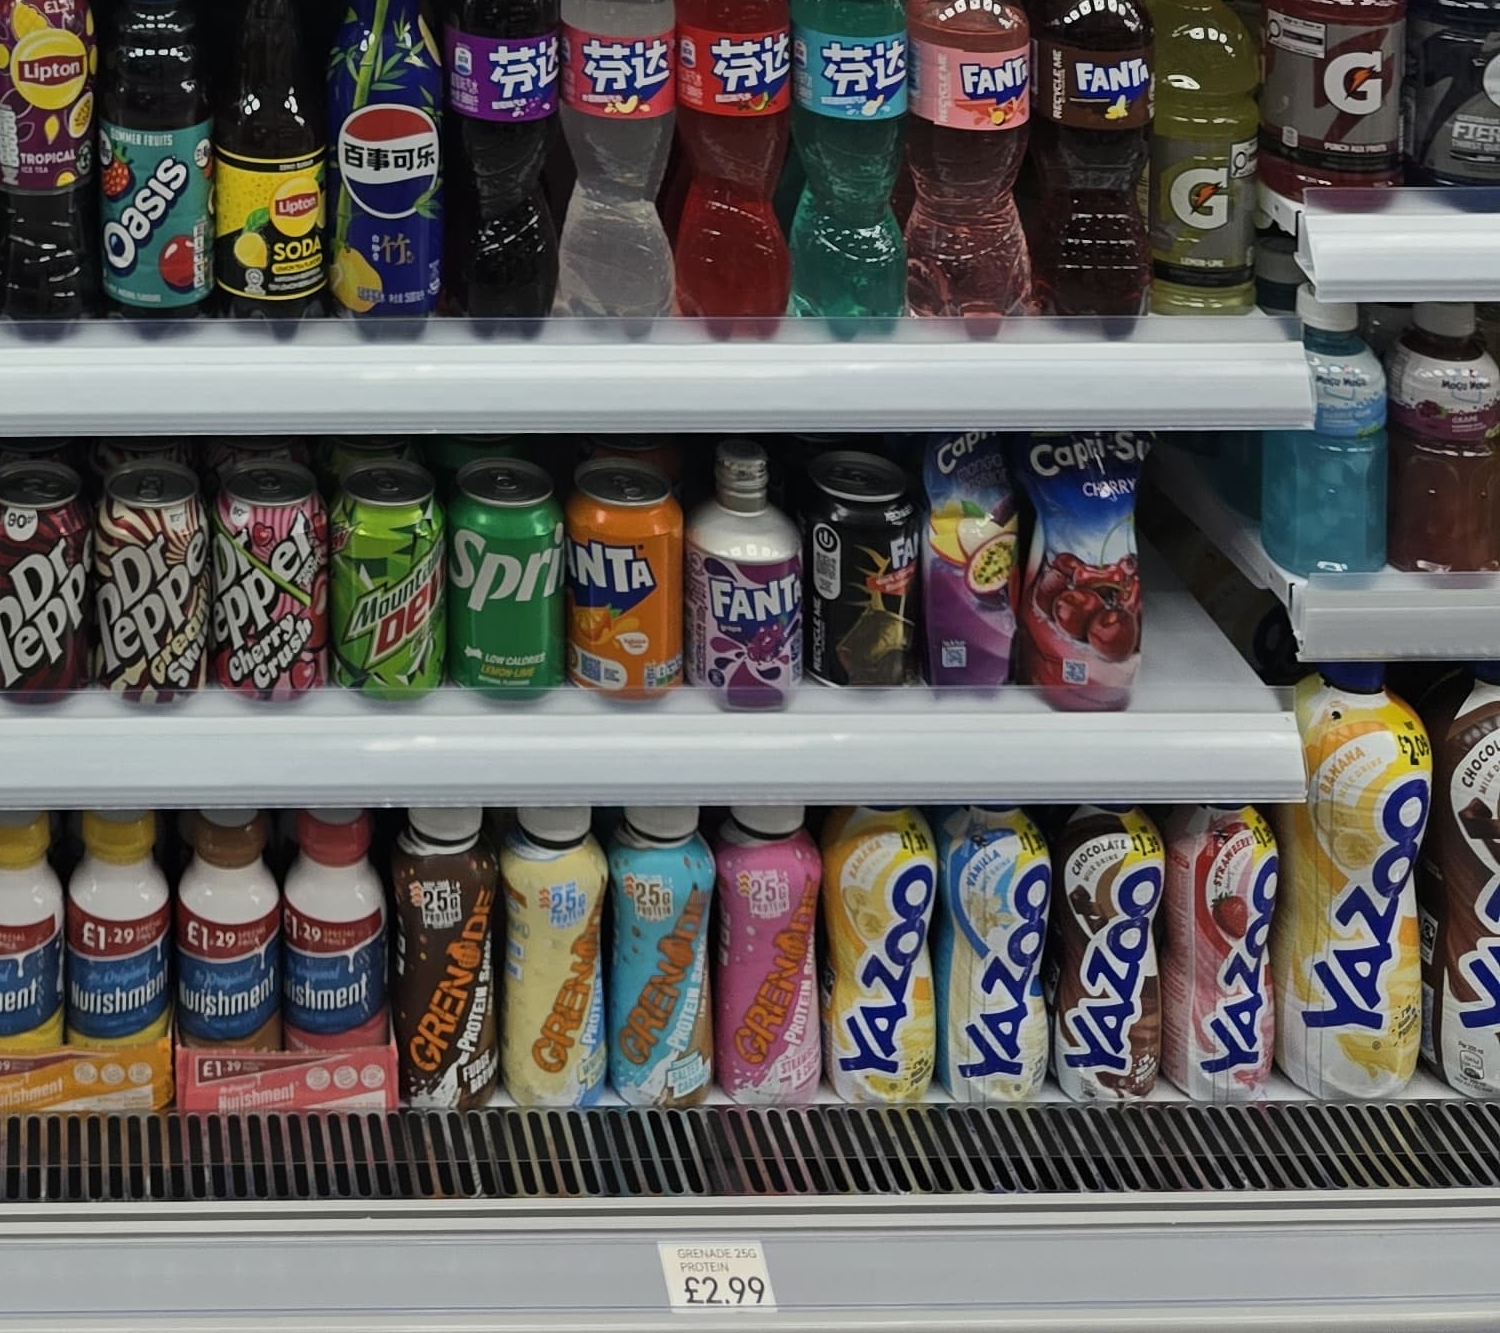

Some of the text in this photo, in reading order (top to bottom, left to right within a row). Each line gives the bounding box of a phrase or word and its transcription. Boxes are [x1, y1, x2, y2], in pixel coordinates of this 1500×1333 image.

[23, 59, 81, 80] Lipton
[582, 39, 670, 93] 芬达
[710, 34, 791, 93] 芬达
[1323, 50, 1383, 116] G
[20, 150, 76, 165] TROPICAL
[343, 142, 438, 173] 百事可乐
[1169, 167, 1229, 230] G
[273, 239, 322, 261] SODA
[228, 612, 296, 682] Cherry
[251, 616, 313, 691] Crush
[1318, 744, 1366, 795] BANANA
[1070, 838, 1128, 878] CHOCOLATE
[422, 888, 461, 915] 25G
[550, 888, 586, 913] 25G
[1300, 778, 1429, 1030] YAZOO
[82, 922, 135, 951] £1.29
[186, 921, 236, 949] £1.29
[839, 864, 935, 1075] YAZOO
[958, 863, 1051, 1079] YAZOO
[1065, 865, 1162, 1072] YAZOO
[71, 970, 168, 1013] Nurishment
[677, 1248, 757, 1259] GRENADE 25G
[680, 1262, 729, 1272] PROTEIN
[684, 1276, 764, 1304] £2.99
